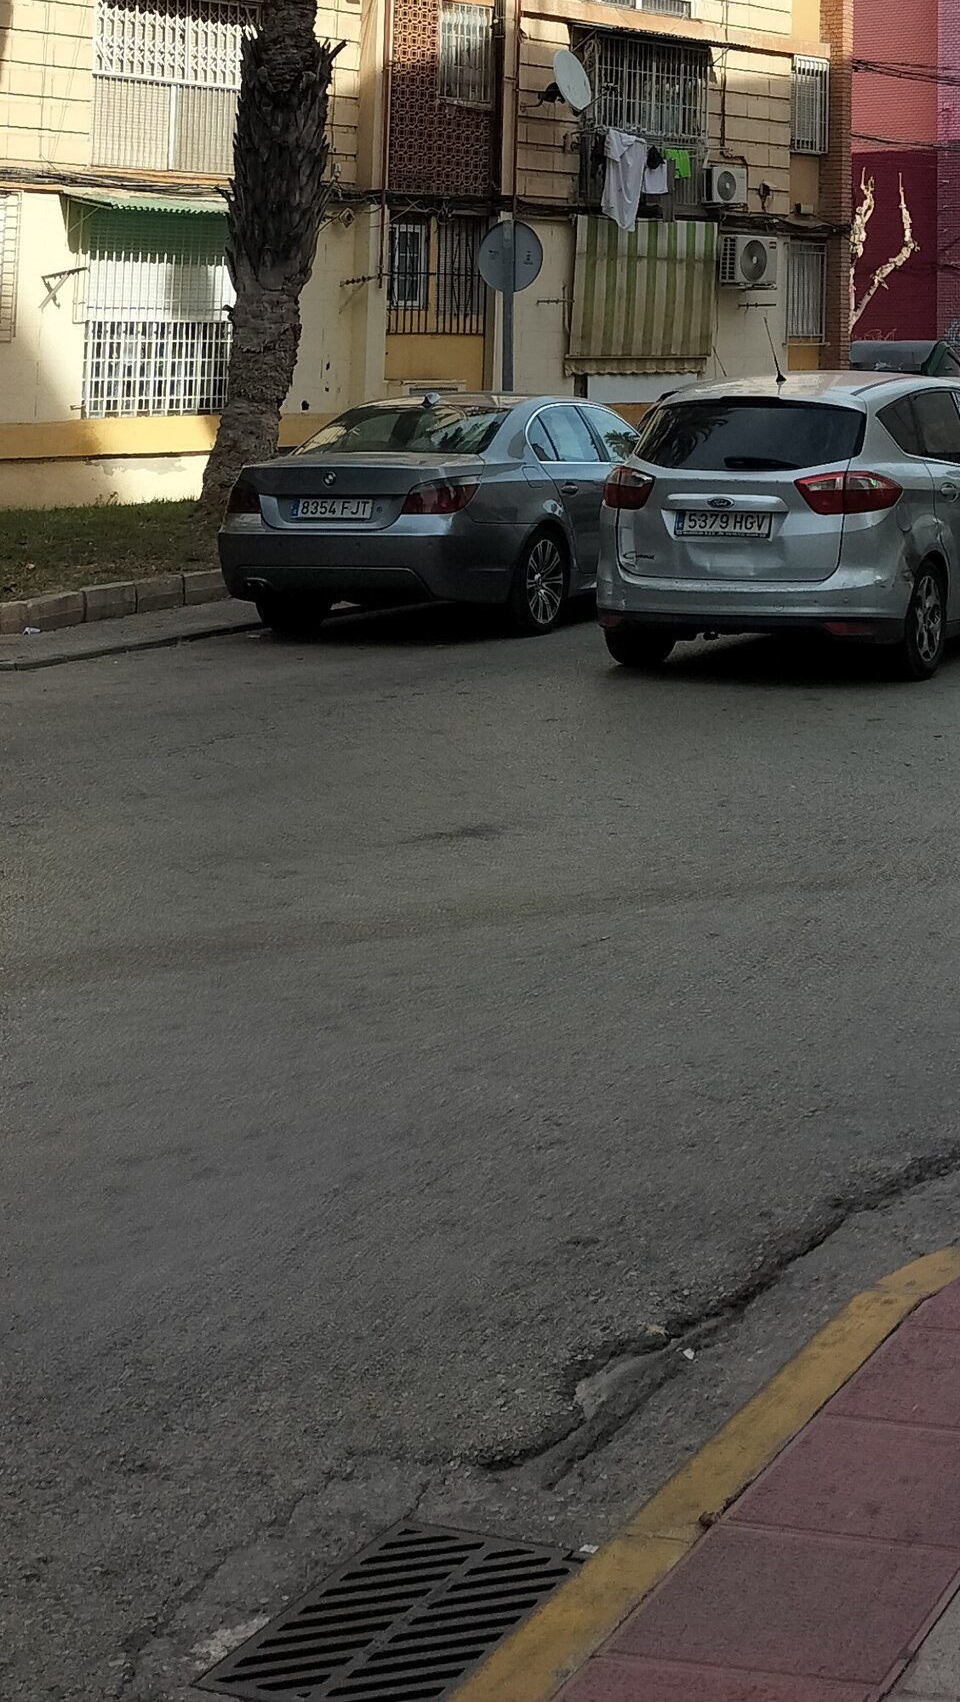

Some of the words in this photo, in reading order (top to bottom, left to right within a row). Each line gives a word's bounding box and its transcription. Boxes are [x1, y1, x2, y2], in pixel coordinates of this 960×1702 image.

[301, 501, 336, 515] 8354
[341, 501, 369, 515] FJT
[688, 513, 729, 530] 5379
[733, 514, 766, 531] HGV
